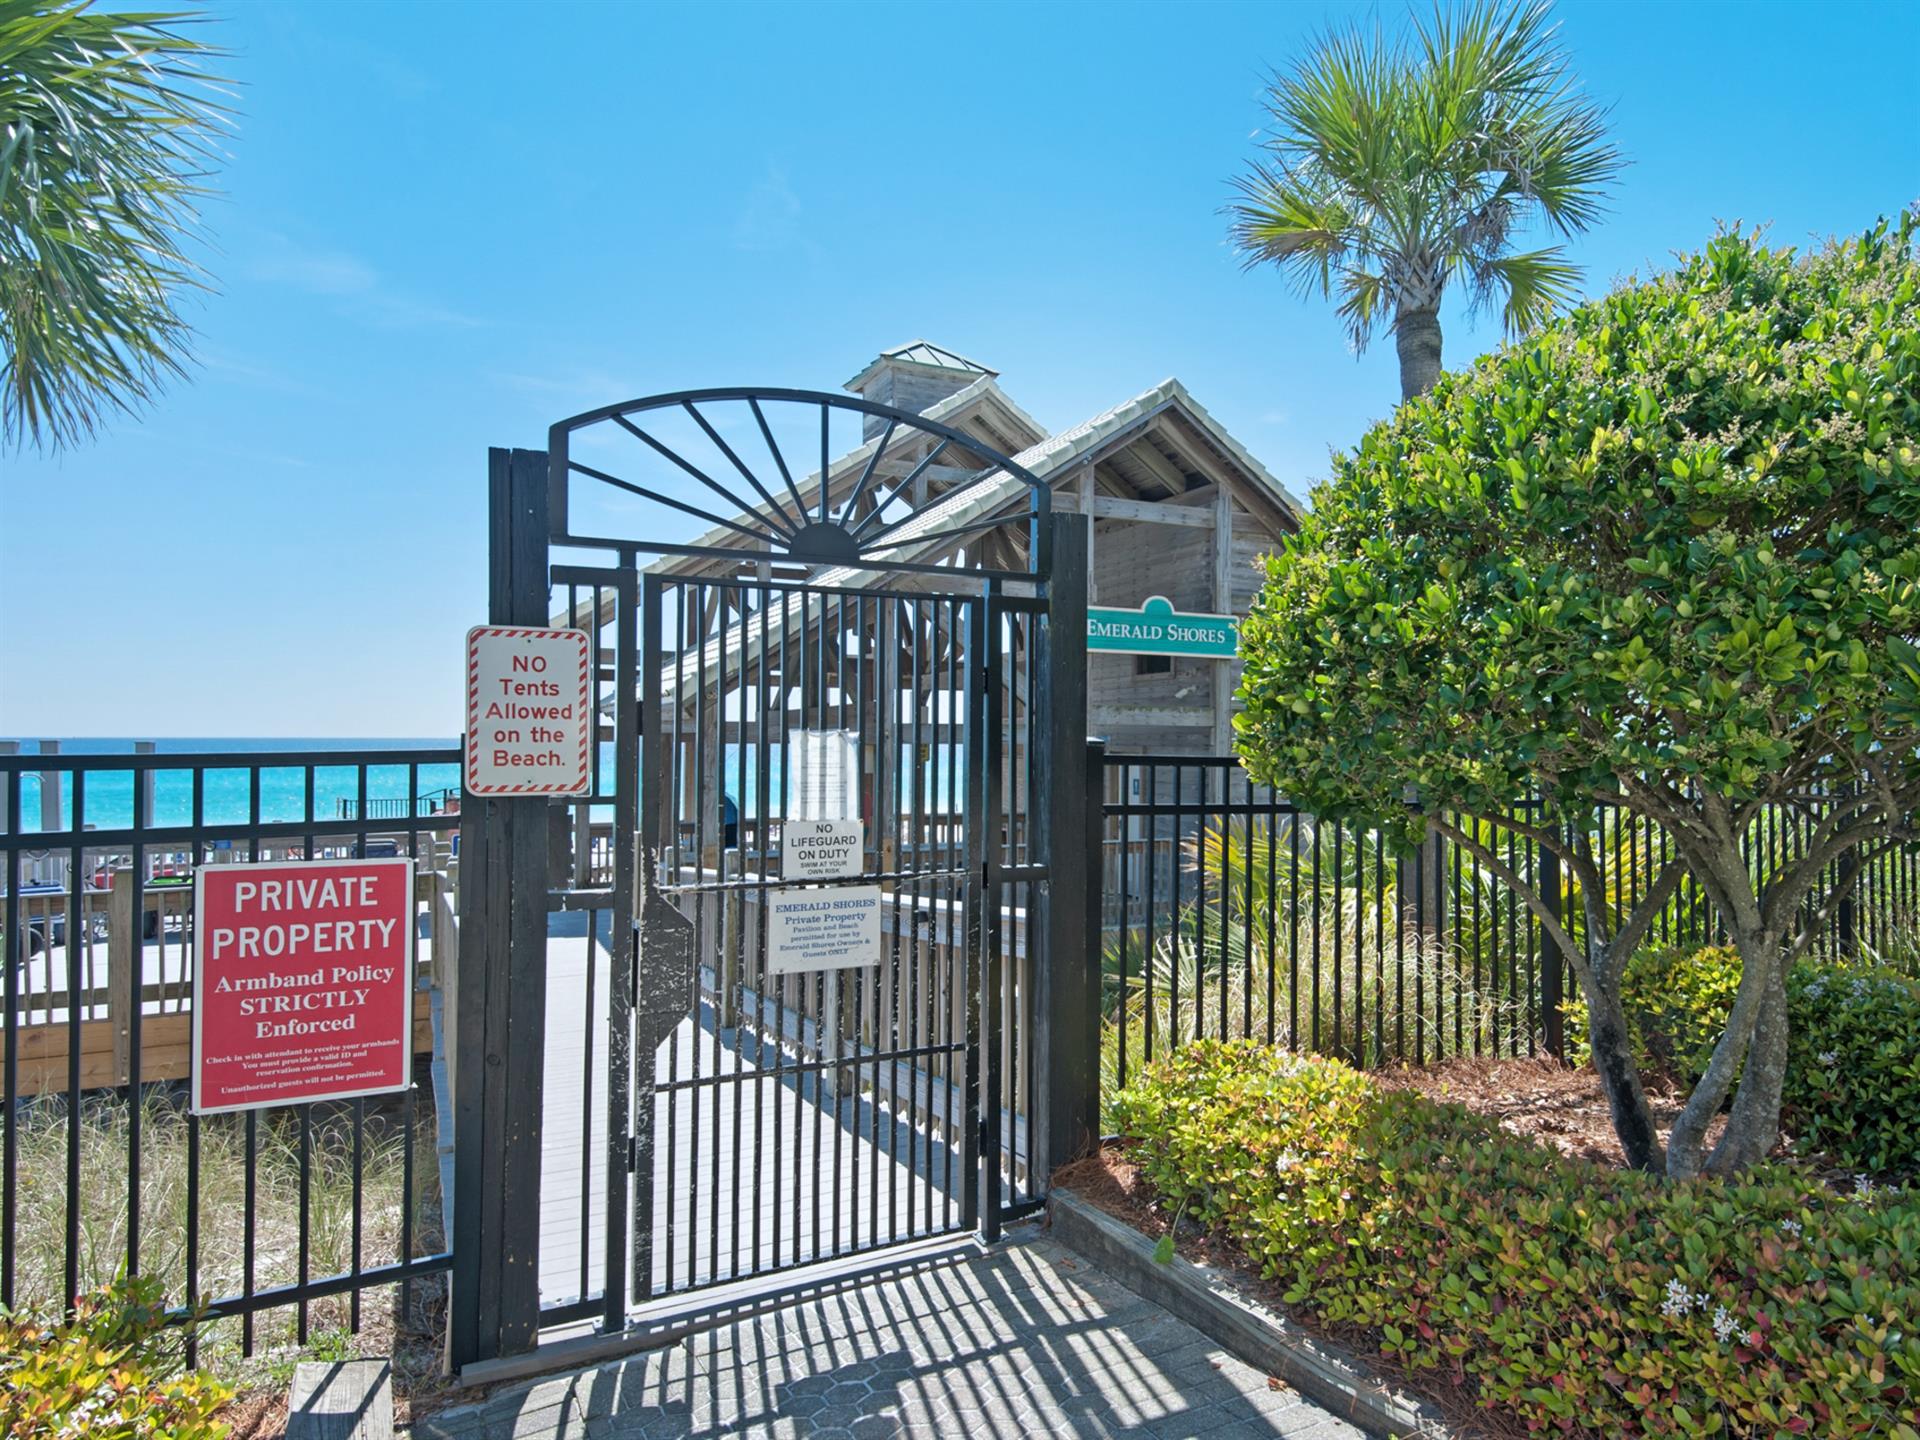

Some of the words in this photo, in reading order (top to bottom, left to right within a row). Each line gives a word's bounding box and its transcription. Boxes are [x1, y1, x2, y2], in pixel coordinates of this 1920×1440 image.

[1087, 618, 1162, 640] EMERALD
[1167, 623, 1226, 644] SHORES
[512, 655, 547, 673] NO
[499, 678, 560, 696] Tents
[485, 702, 573, 720] Allowed
[494, 729, 520, 743] on
[530, 726, 565, 743] the
[493, 750, 566, 767] Beach.
[816, 823, 833, 833] NO
[791, 835, 857, 847] LIFEGUARD
[798, 850, 816, 860] ON
[819, 848, 850, 859] DUTY
[235, 876, 379, 913] PRIVATE
[775, 902, 831, 913] EMERALD
[833, 898, 876, 909] SHORES
[785, 915, 822, 925] Private
[824, 912, 866, 922] Property
[793, 925, 822, 933] Pavilion
[212, 918, 397, 960] PROPERTY
[780, 943, 810, 951] Emerald
[811, 941, 836, 949] Shores
[790, 934, 826, 943] permitted
[828, 948, 849, 956] ONLY
[214, 968, 324, 994] Armband
[332, 964, 395, 985] Policy
[239, 988, 371, 1016] STRICTLY
[256, 1013, 356, 1039] Enforced
[206, 1055, 233, 1065] Check
[234, 1054, 244, 1062] in
[245, 1051, 263, 1061] with
[264, 1048, 303, 1059] attendant
[304, 1047, 313, 1055] to
[313, 1044, 341, 1054] receive
[342, 1042, 360, 1052] your
[361, 1038, 400, 1048] armbands
[242, 1061, 259, 1070] You
[260, 1059, 280, 1068] must
[281, 1055, 313, 1068] provide
[320, 1052, 340, 1061] valid
[341, 1051, 352, 1059] ID
[352, 1050, 368, 1058] and
[256, 1066, 301, 1077] reservation
[302, 1061, 354, 1073] confirmation.
[221, 1081, 277, 1095] Unauthorized
[278, 1079, 303, 1090] guests
[304, 1076, 320, 1085] will
[320, 1075, 335, 1083] not
[335, 1073, 345, 1081] be
[345, 1069, 387, 1082] permitted.
